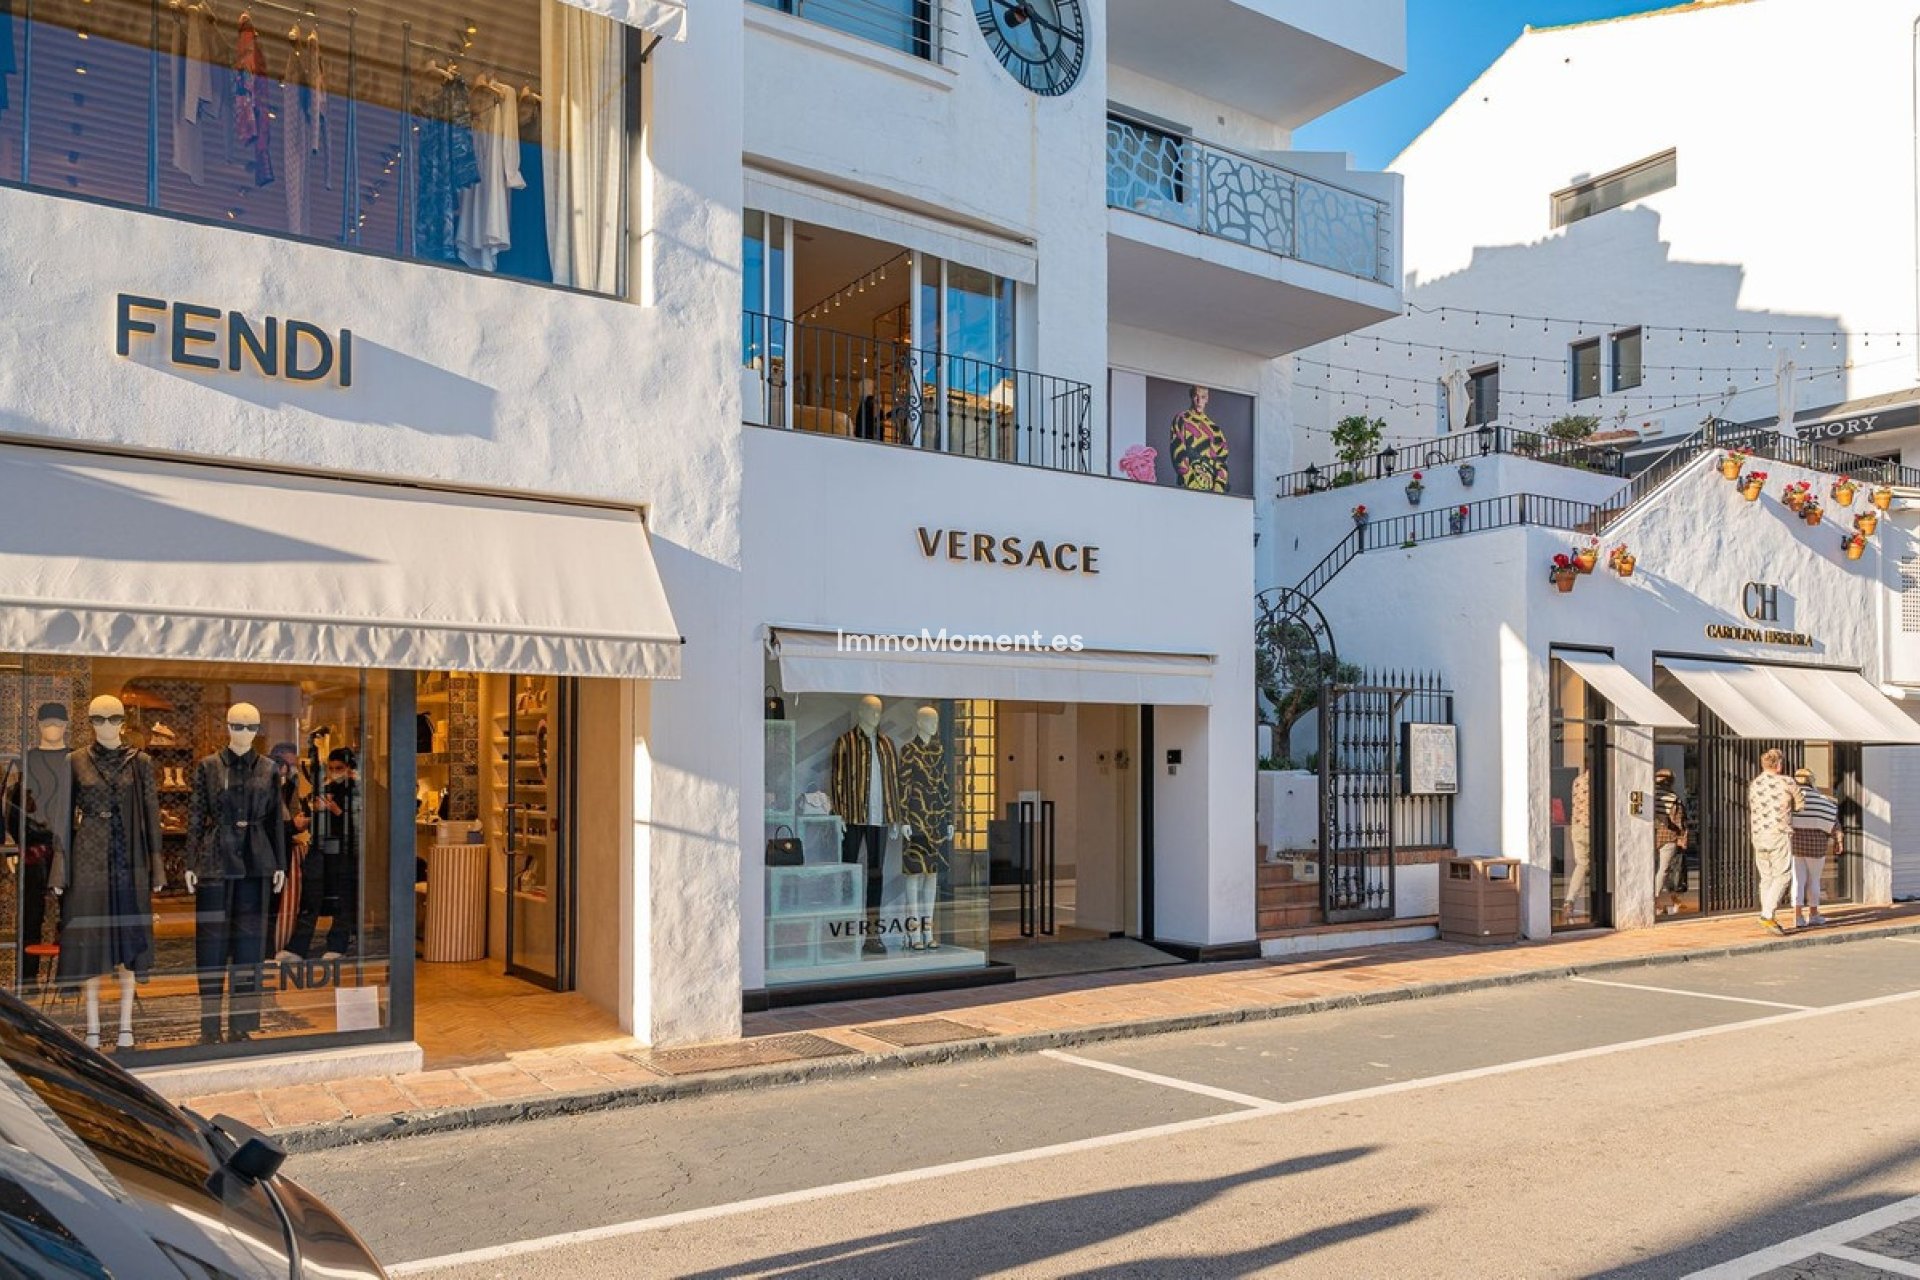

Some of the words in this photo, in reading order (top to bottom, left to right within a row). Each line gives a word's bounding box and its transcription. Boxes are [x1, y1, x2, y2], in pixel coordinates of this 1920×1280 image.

[117, 293, 352, 387] FENDI
[917, 526, 1101, 575] VERSACE
[1742, 581, 1779, 621] CH
[1705, 624, 1762, 642] CAROLINA
[1765, 630, 1814, 647] HERRERA
[828, 915, 932, 938] VERSACE
[230, 960, 342, 997] FENDI
